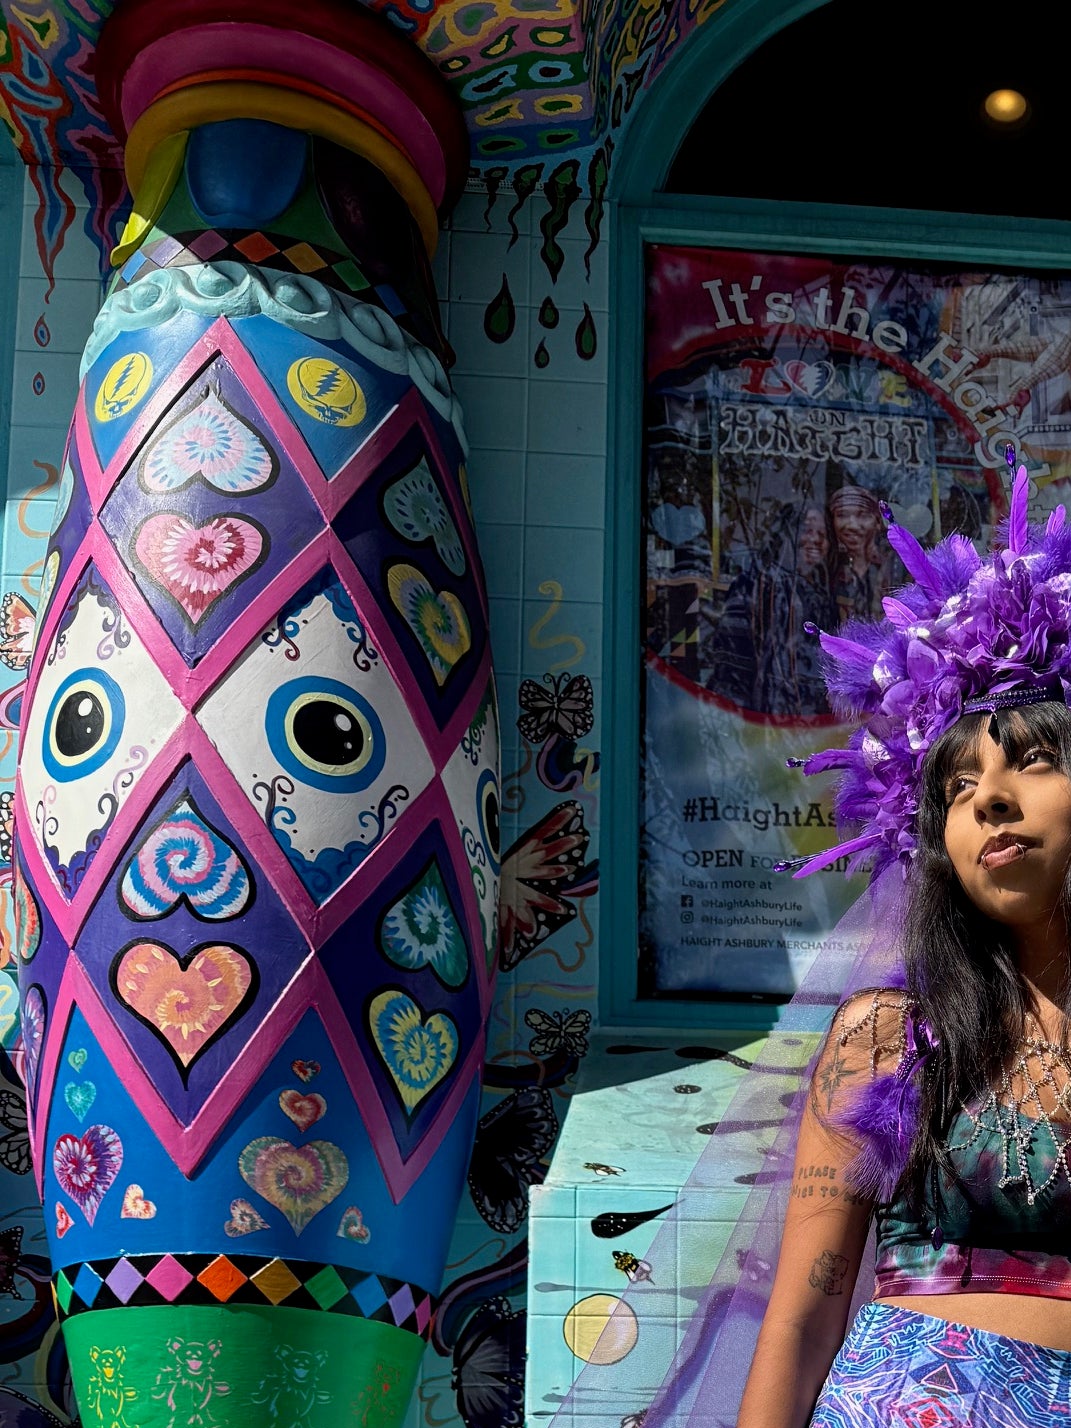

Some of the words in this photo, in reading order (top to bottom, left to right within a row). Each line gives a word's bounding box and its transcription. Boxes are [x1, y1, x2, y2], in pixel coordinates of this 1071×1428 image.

[702, 275, 796, 330] It's
[813, 286, 908, 352] the
[808, 409, 847, 426] ON
[719, 405, 929, 468] HAIGHT
[683, 797, 838, 831] #HaightAs
[682, 849, 744, 868] OPEN
[750, 855, 784, 870] FO
[682, 875, 718, 889] Learn
[721, 880, 756, 889] more
[759, 880, 772, 890] at
[701, 898, 803, 912] @HaightAshburyLife
[701, 915, 803, 928] @HaightAshburyLife
[681, 936, 722, 946] HAIGHT
[724, 938, 775, 949] ASHBURY
[777, 940, 844, 951] MERCHANTS
[820, 1185, 839, 1198] TO
